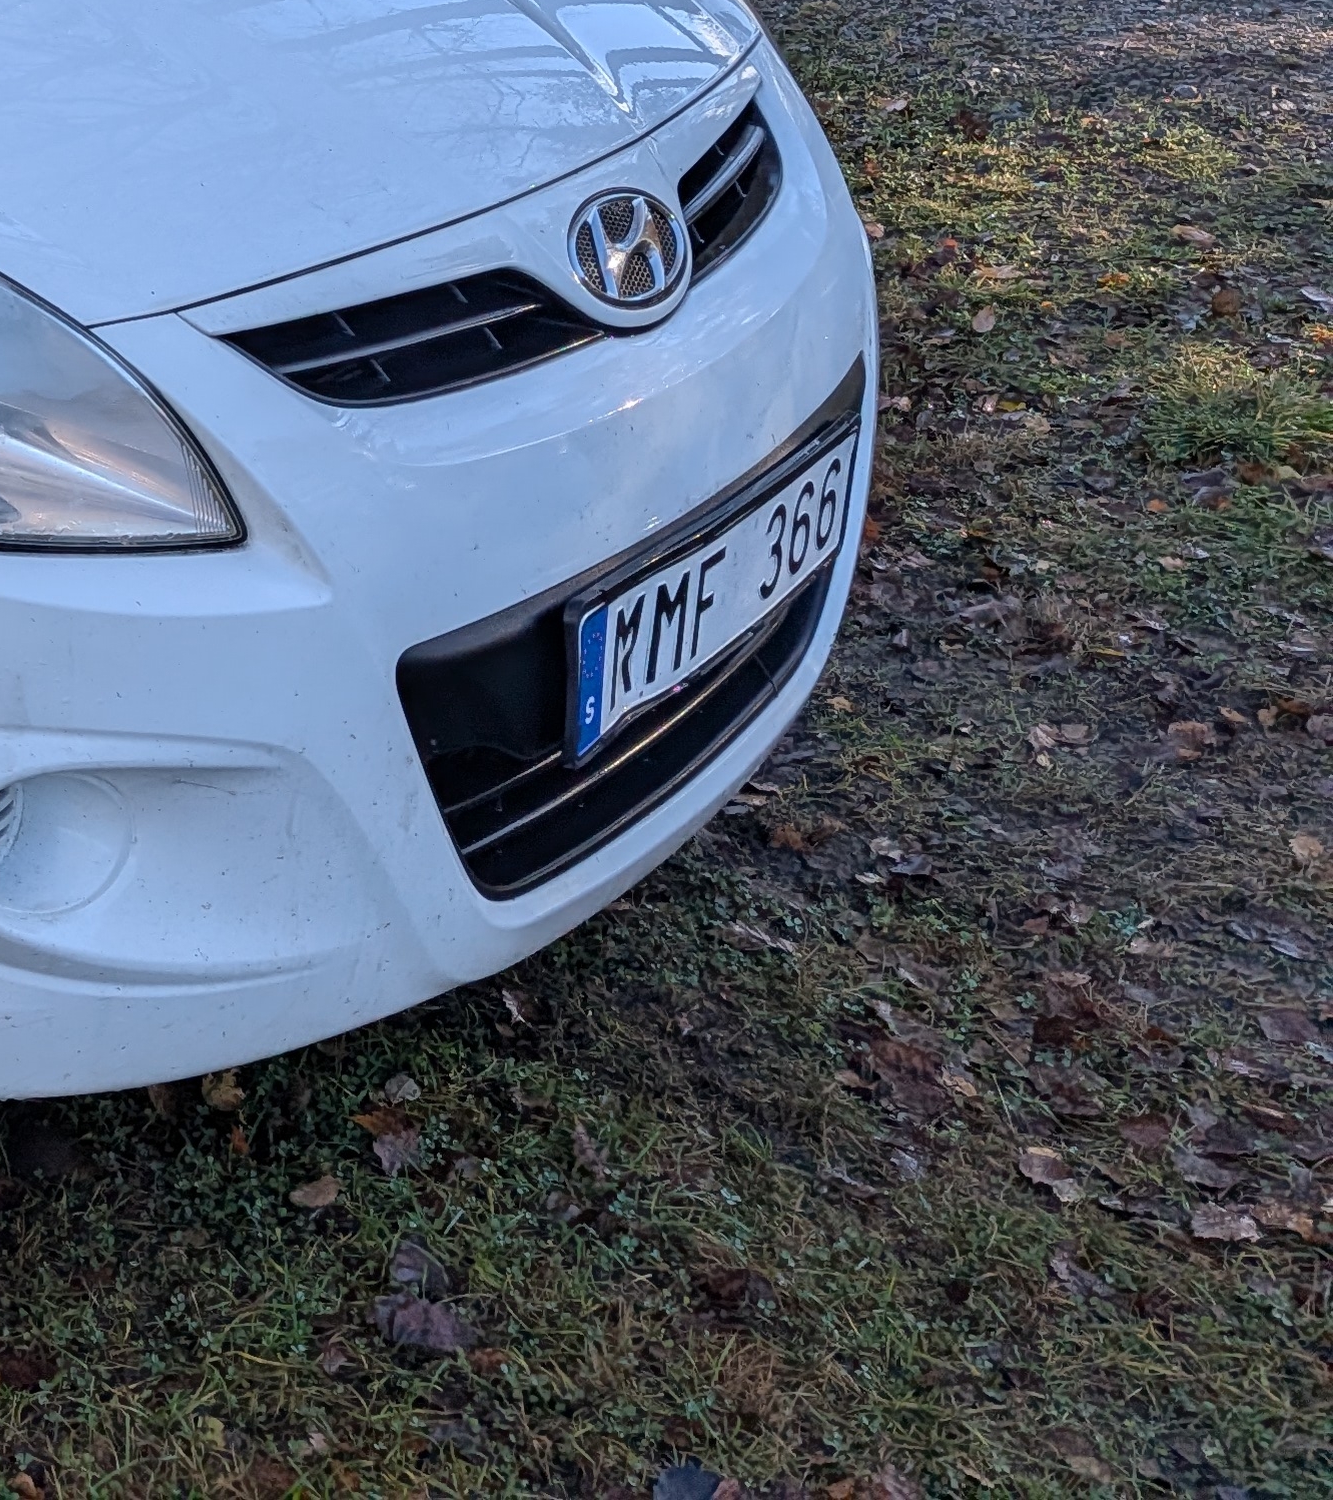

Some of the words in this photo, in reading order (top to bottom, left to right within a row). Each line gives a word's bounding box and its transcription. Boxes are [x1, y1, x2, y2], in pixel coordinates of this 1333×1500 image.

[609, 546, 727, 712] KMF
[758, 457, 842, 600] 366
[585, 695, 596, 725] S
